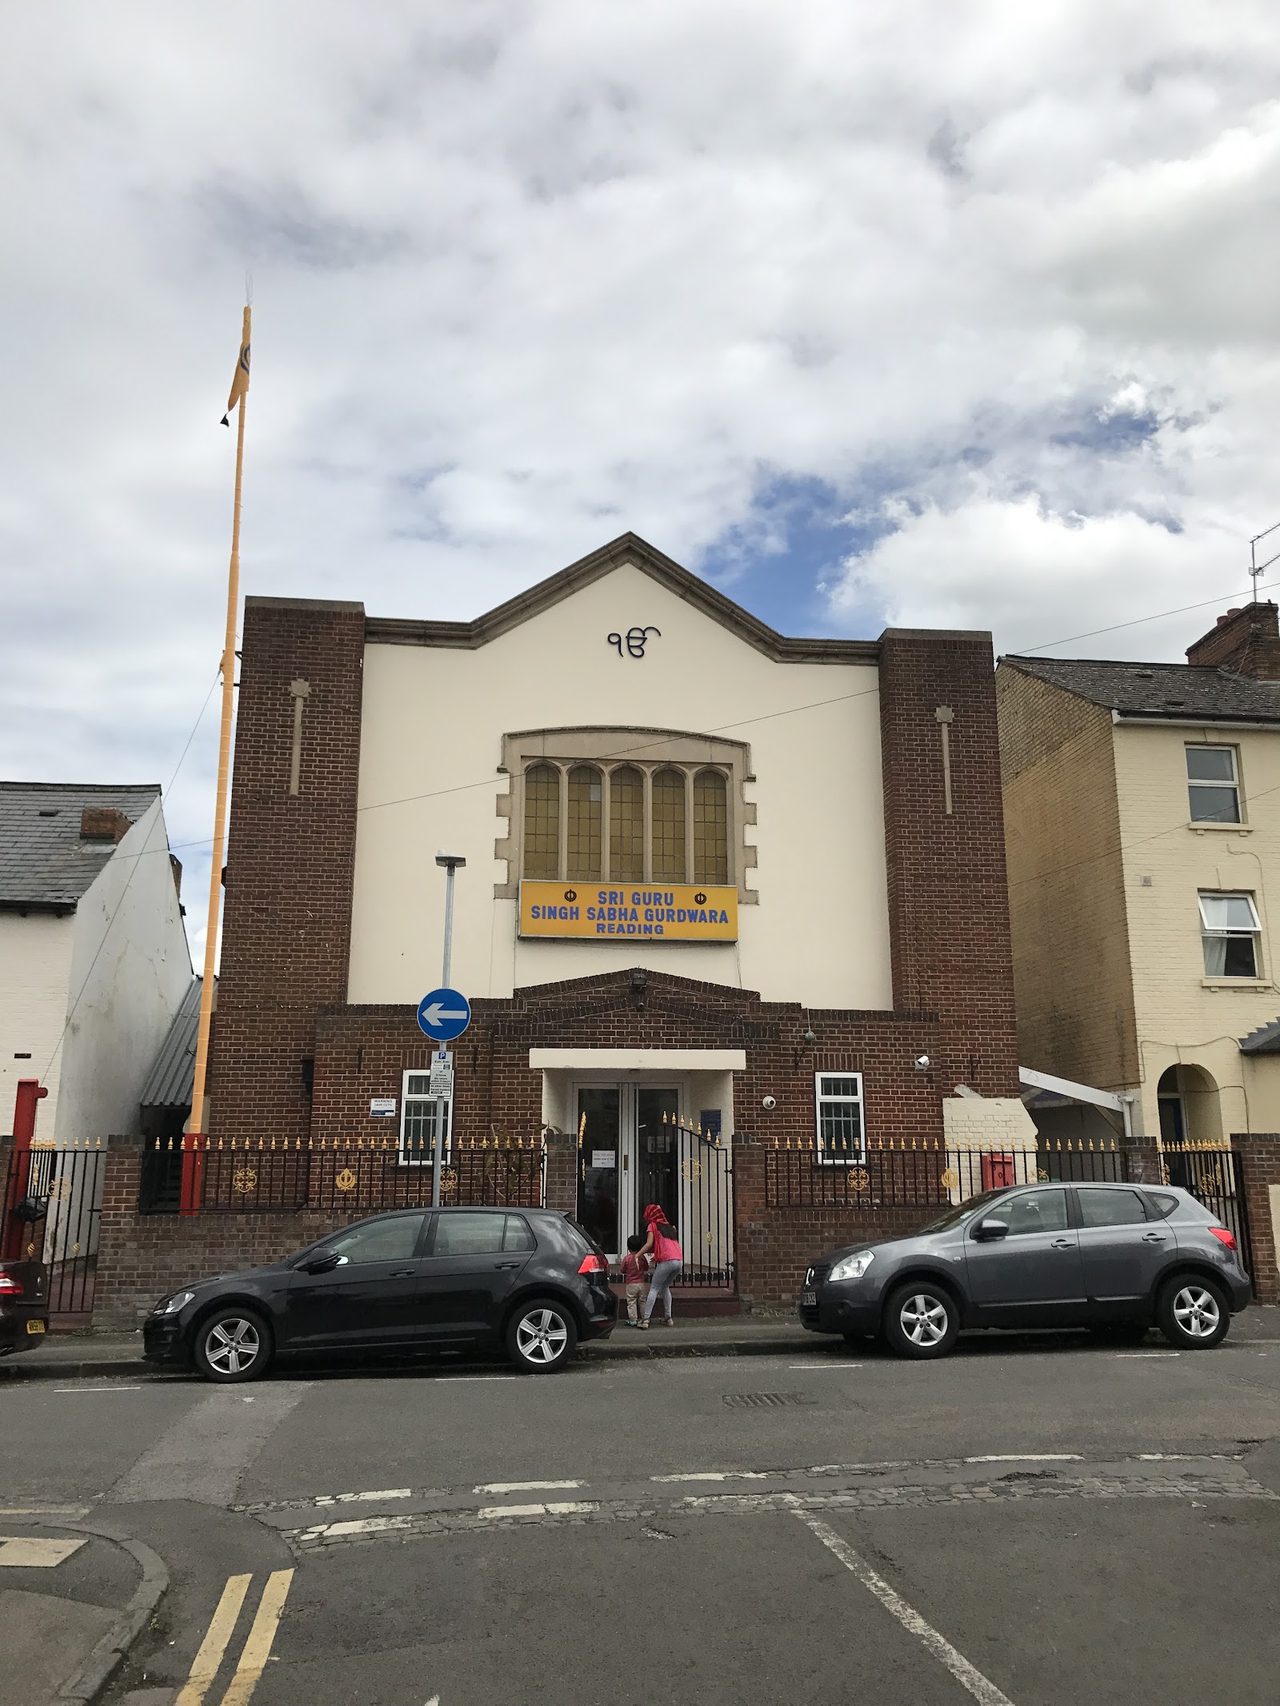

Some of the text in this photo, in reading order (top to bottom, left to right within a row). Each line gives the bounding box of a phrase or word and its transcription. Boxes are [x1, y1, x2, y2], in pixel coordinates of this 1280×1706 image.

[597, 891, 674, 906] SRI GURU
[531, 905, 729, 924] SINGH SABHA GURDWARA
[596, 923, 664, 935] READING
